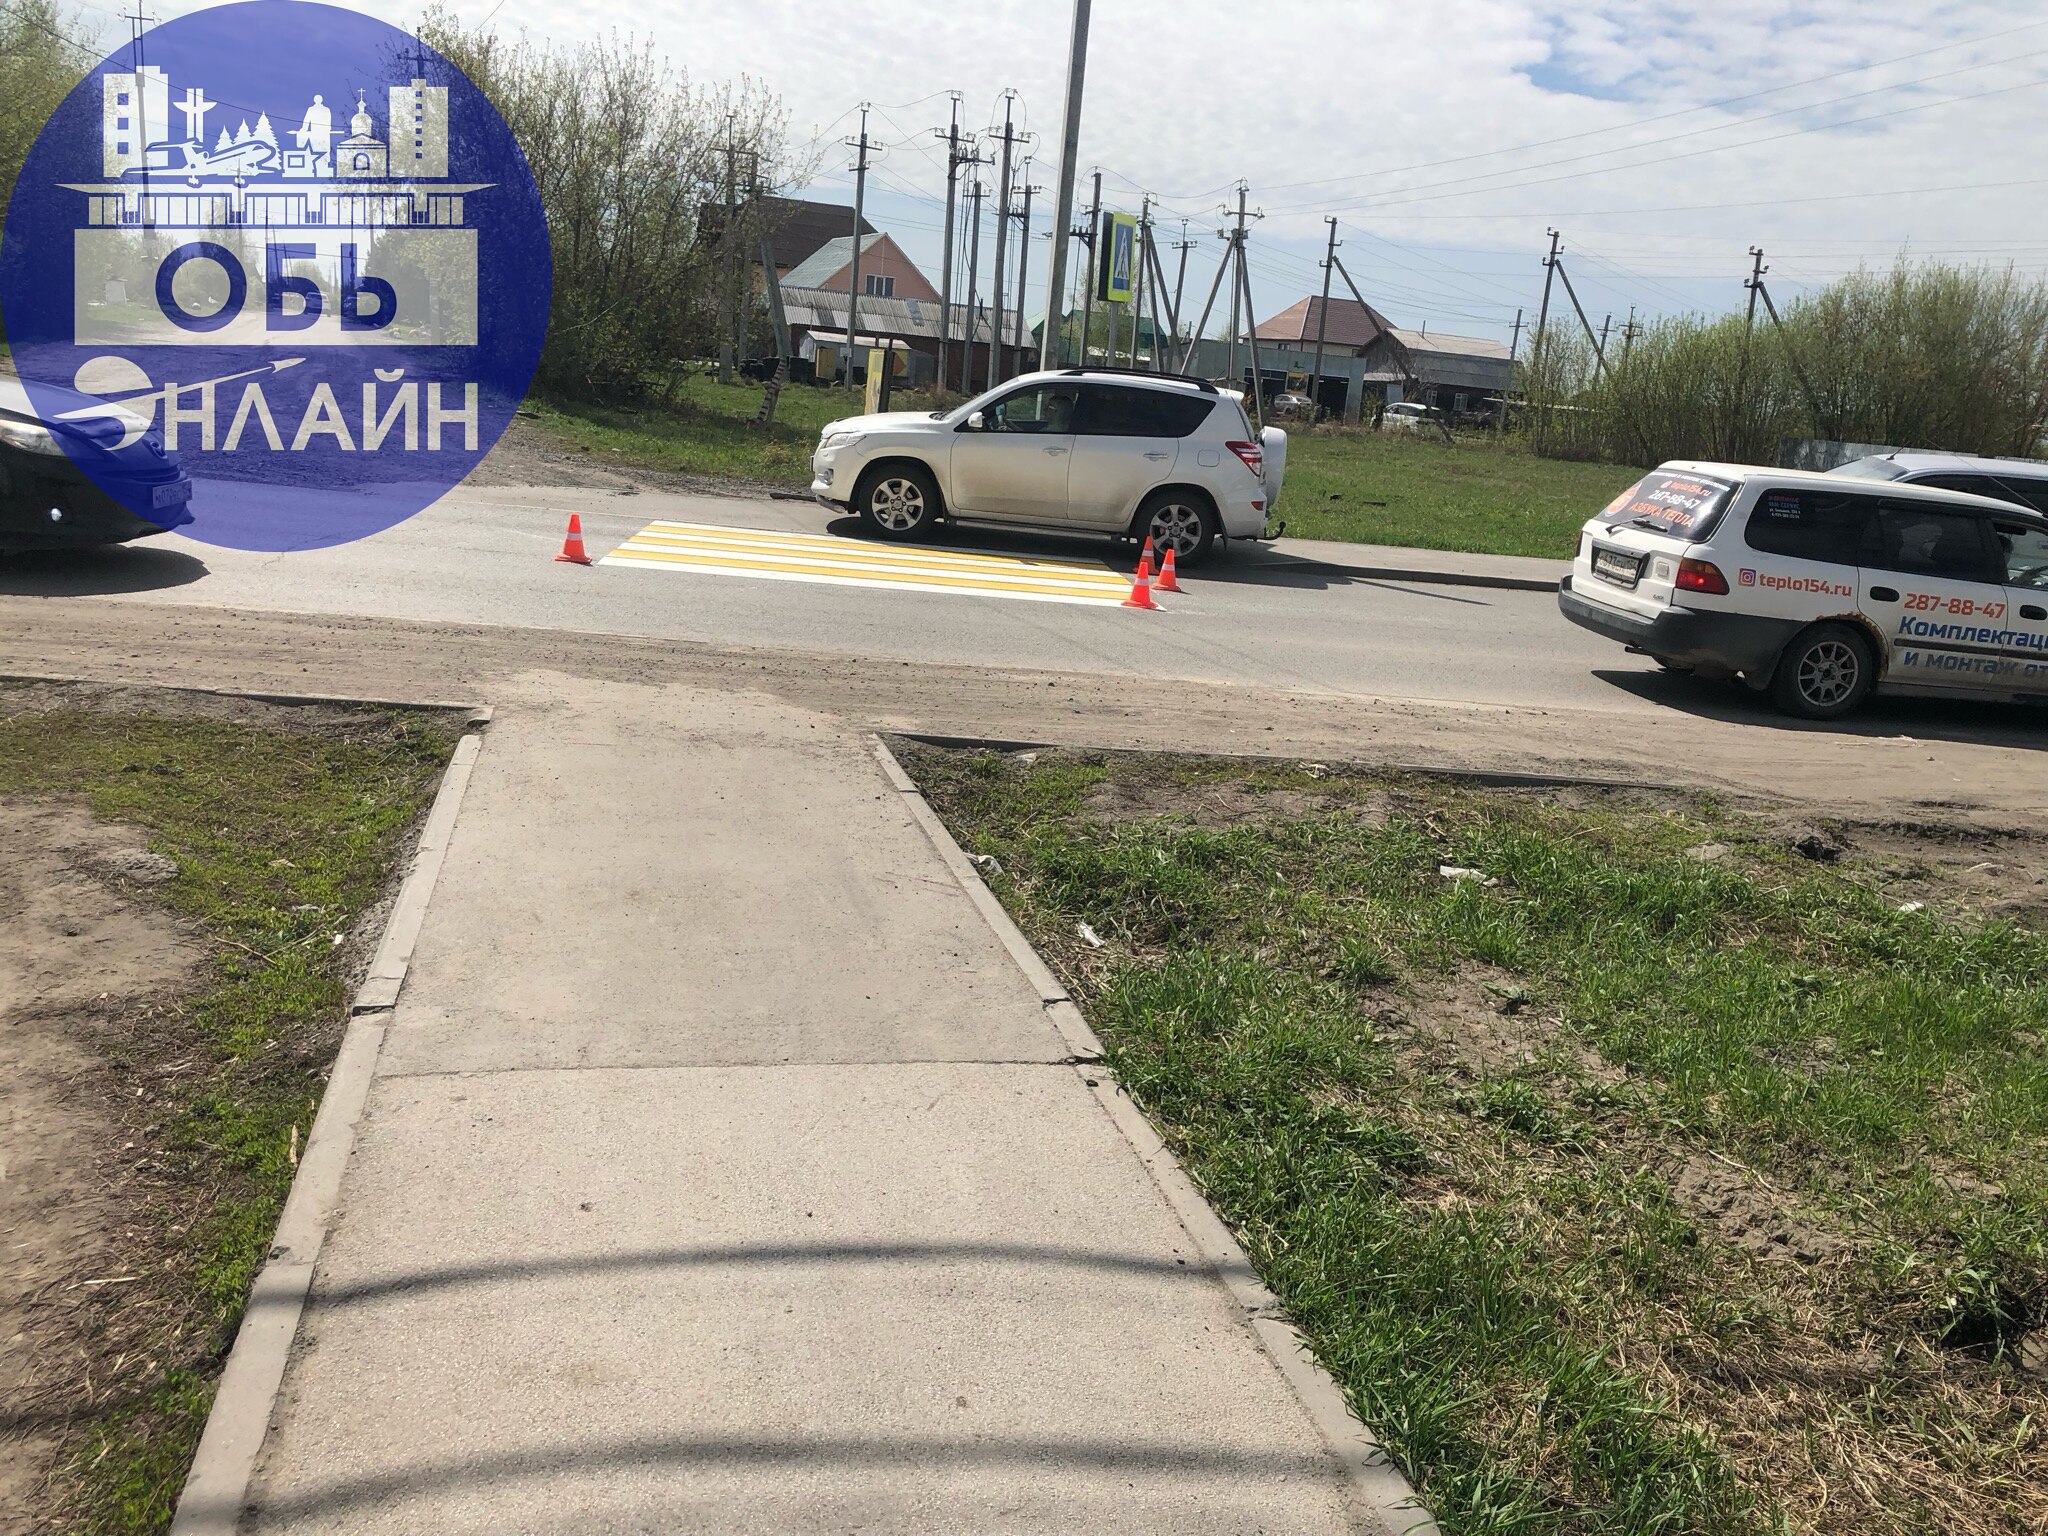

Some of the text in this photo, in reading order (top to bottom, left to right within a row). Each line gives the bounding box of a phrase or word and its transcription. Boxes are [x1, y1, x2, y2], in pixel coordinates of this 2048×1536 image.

[1647, 489, 1702, 510] 287-88-47
[1662, 507, 1696, 528] ТЕПЛА
[1759, 573, 1853, 597] teplo154.ru
[1903, 592, 2006, 619] 287-88-47
[1903, 651, 1920, 667] и
[1924, 652, 2019, 676] монтаж
